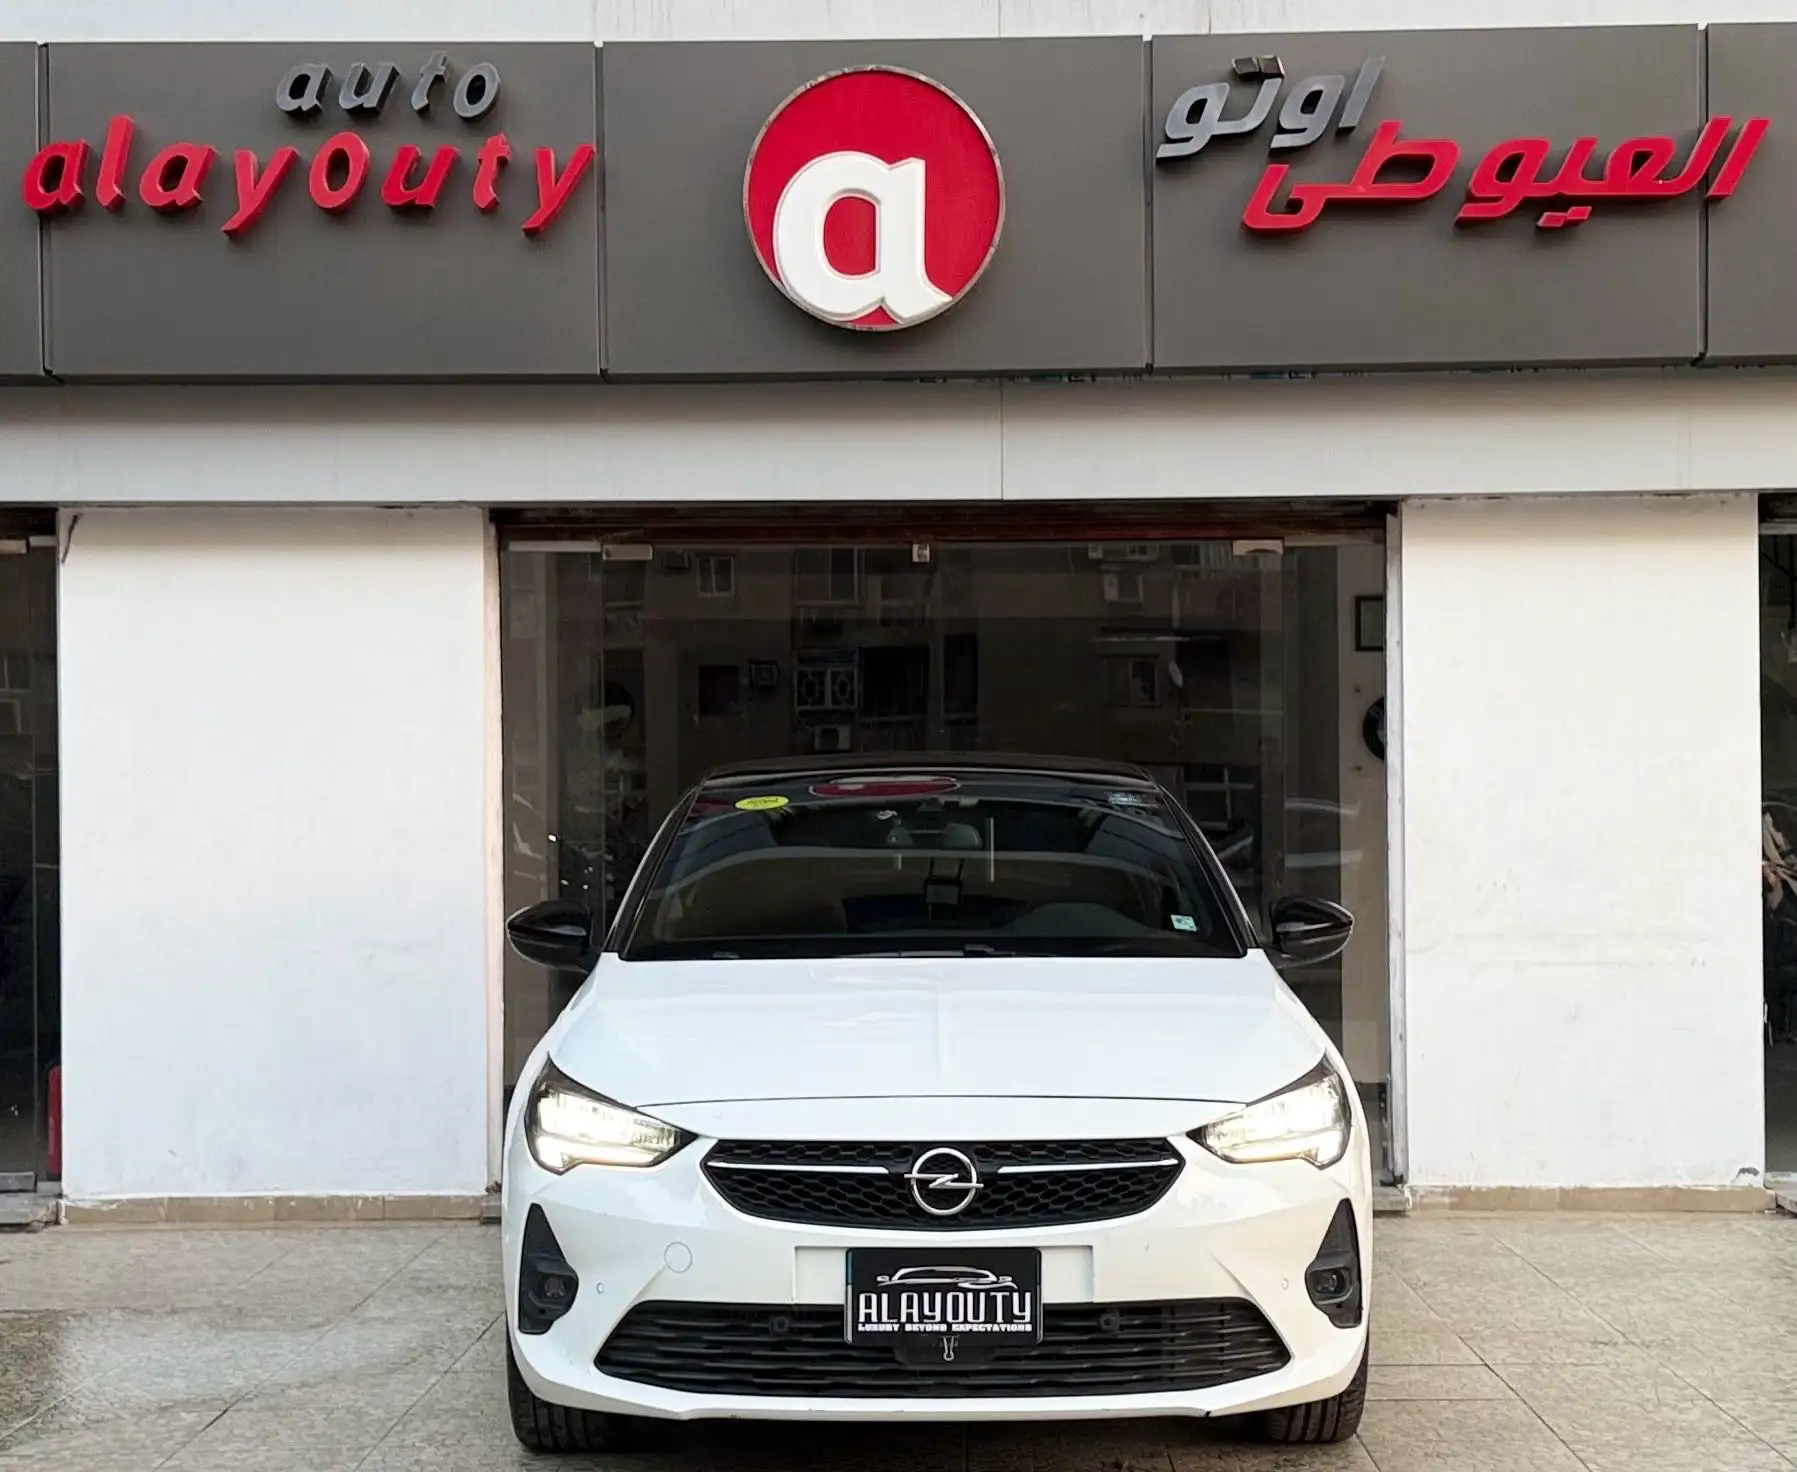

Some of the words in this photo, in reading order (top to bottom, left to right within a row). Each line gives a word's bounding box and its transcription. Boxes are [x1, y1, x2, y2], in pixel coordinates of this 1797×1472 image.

[276, 51, 500, 120] auto
[772, 150, 952, 324] a
[857, 1323, 900, 1332] LUXURY
[904, 1323, 948, 1332] BEYOND
[951, 1323, 1033, 1332] EXPECTATIONS
[858, 1291, 1032, 1324] ALAYOUTY
